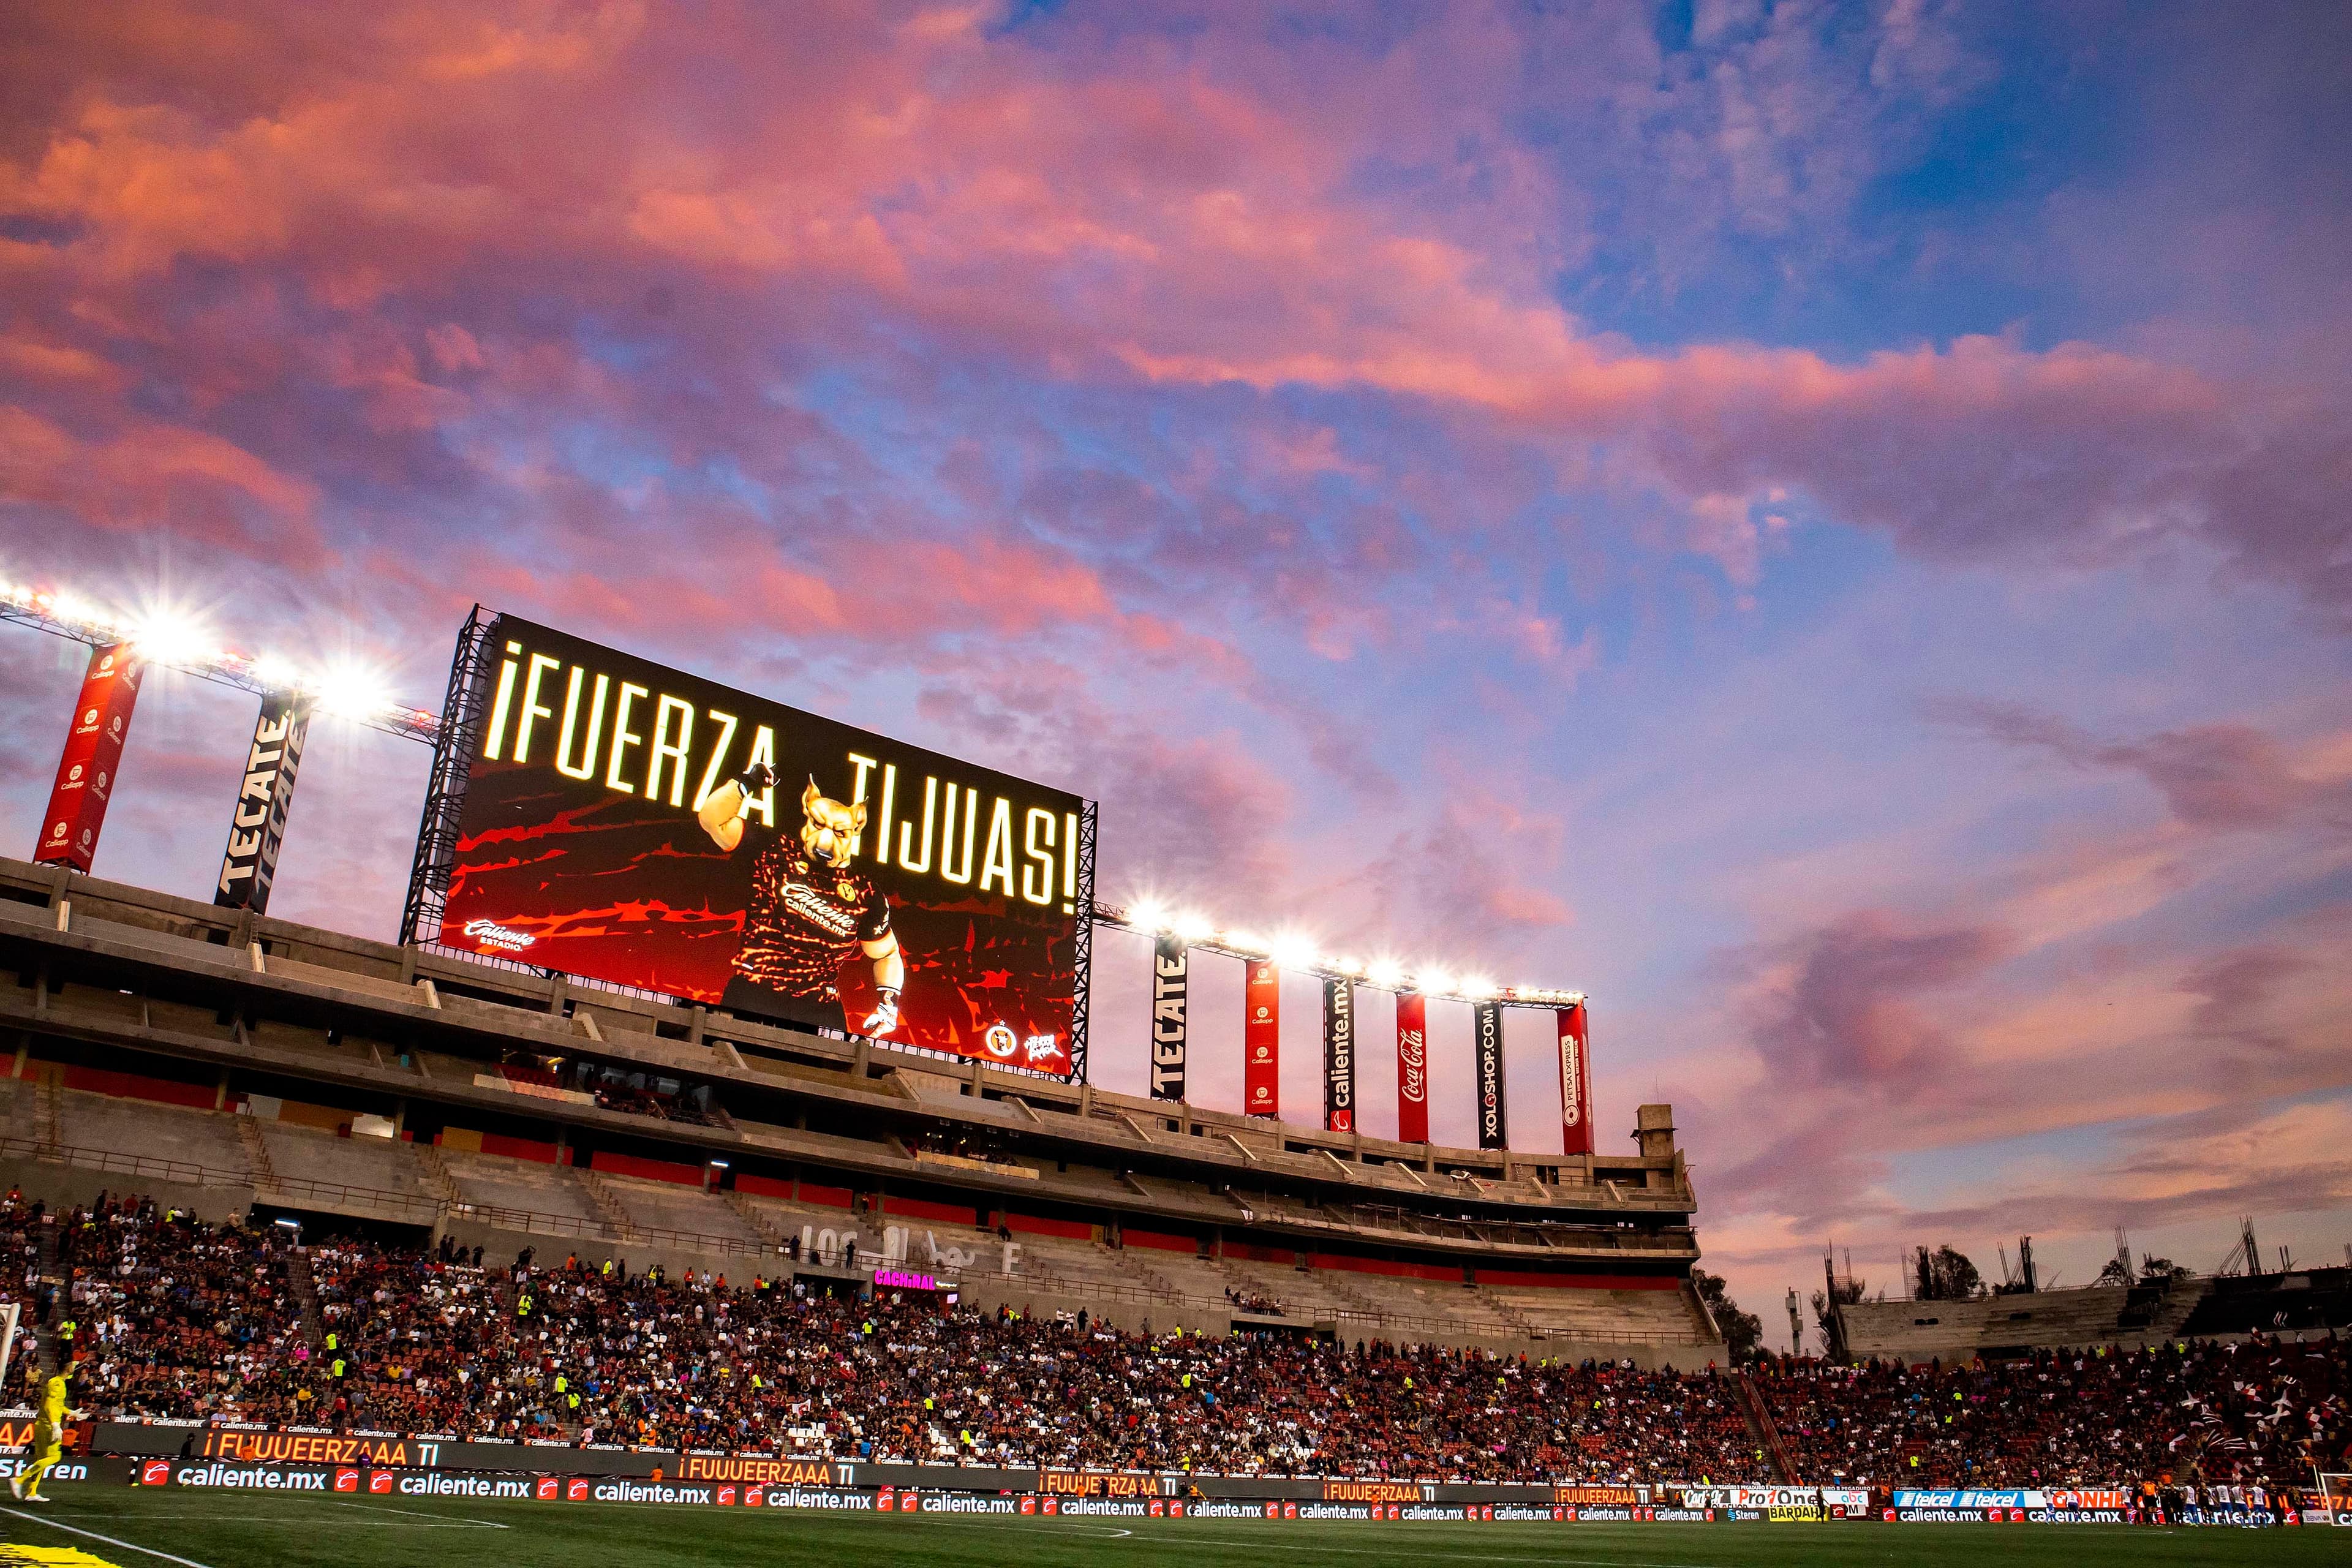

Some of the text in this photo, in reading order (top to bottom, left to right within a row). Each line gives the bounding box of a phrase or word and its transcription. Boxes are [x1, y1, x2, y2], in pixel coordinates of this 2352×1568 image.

[484, 641, 775, 829] ¡FUERZA
[220, 714, 288, 894] TECATE
[255, 710, 305, 895] TECATE
[848, 752, 1077, 914] TIJUAS!
[785, 898, 847, 937] caliente.mx
[464, 919, 536, 946] Caliente
[1153, 954, 1186, 1093] TECATE
[1331, 979, 1349, 1107] caliente.mx
[1483, 1009, 1497, 1138] XOLOSHOP.COM
[153, 1419, 203, 1428] caliente.mx
[221, 1421, 268, 1431] caliente.mx
[287, 1425, 333, 1434] caliente.mx
[354, 1428, 397, 1438] caliente.mx
[415, 1432, 457, 1442] caliente.mx
[474, 1436, 514, 1445] caliente.mx
[417, 1443, 439, 1466] TI
[0, 1459, 88, 1480] Stren
[178, 1464, 325, 1490] caliente.mx
[690, 1458, 830, 1484] FUUUEERZAAA
[838, 1464, 854, 1484] TI
[399, 1472, 530, 1498] caliente.mx
[594, 1481, 710, 1504] caliente.mx
[1163, 1477, 1175, 1495] TI
[767, 1488, 871, 1510] caliente.mx
[1423, 1487, 1434, 1501] TI
[1561, 1489, 1636, 1504] FUUUEERZAAA
[1638, 1490, 1648, 1504] TI
[1841, 1491, 1863, 1503] abc
[1914, 1492, 1956, 1507] telcel
[1975, 1492, 2018, 1507] telcel
[922, 1494, 1015, 1513] caliente.mx
[1061, 1498, 1145, 1516] caliente.mx
[1186, 1501, 1262, 1517] caliente.mx
[1300, 1504, 1368, 1519] caliente.mx
[1401, 1506, 1464, 1520] caliente.mx
[1494, 1506, 1550, 1520] caliente.mx
[1578, 1507, 1630, 1520] caliente.mx
[1655, 1508, 1703, 1521] caliente.mx
[1735, 1510, 1760, 1520] Steren
[1770, 1507, 1825, 1519] BARDAH
[1899, 1508, 1983, 1521] caliente.mx
